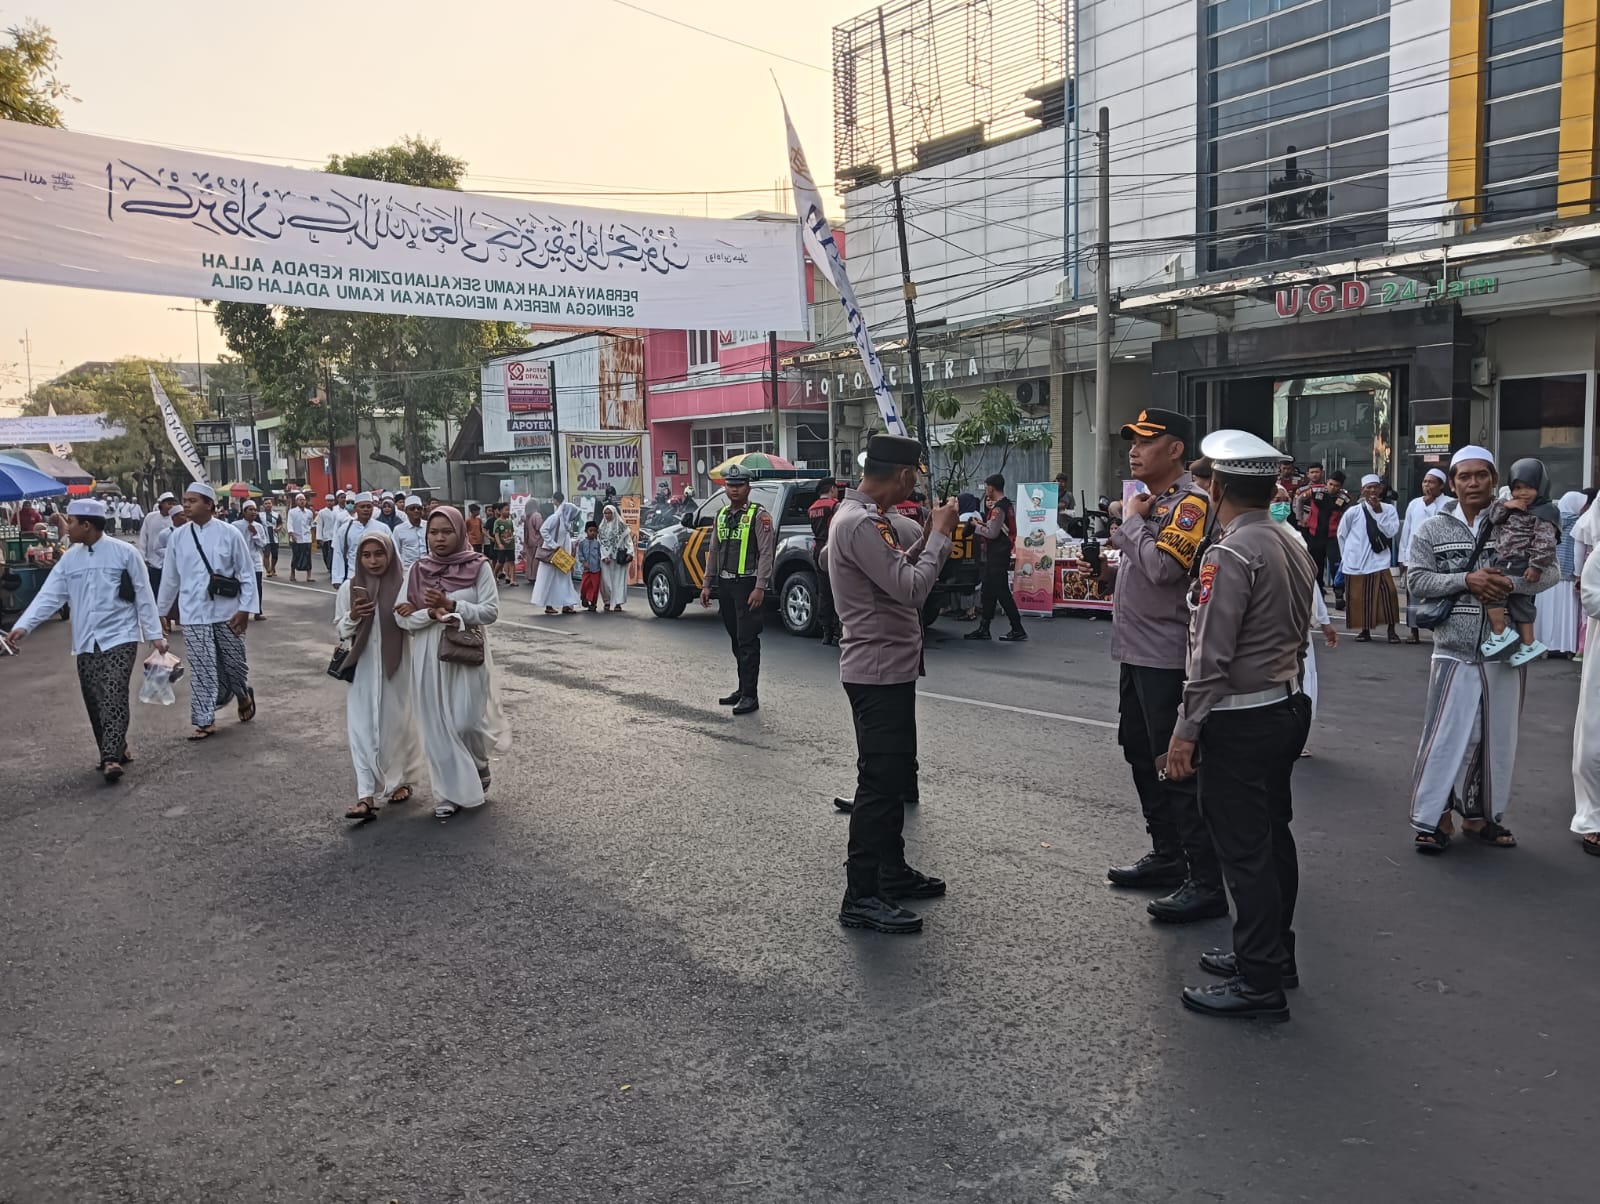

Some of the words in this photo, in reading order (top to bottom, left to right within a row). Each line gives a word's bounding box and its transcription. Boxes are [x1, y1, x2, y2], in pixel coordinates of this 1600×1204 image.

[1275, 280, 1370, 319] UGD
[1381, 280, 1418, 305] 24
[1429, 276, 1499, 299] Jam
[806, 372, 863, 398] FOTO
[888, 356, 979, 387] CITRA
[511, 421, 551, 430] APOTEK
[570, 444, 611, 459] APOTEK
[614, 444, 639, 459] DIVA
[607, 461, 639, 478] BUKA
[577, 474, 598, 491] 24
